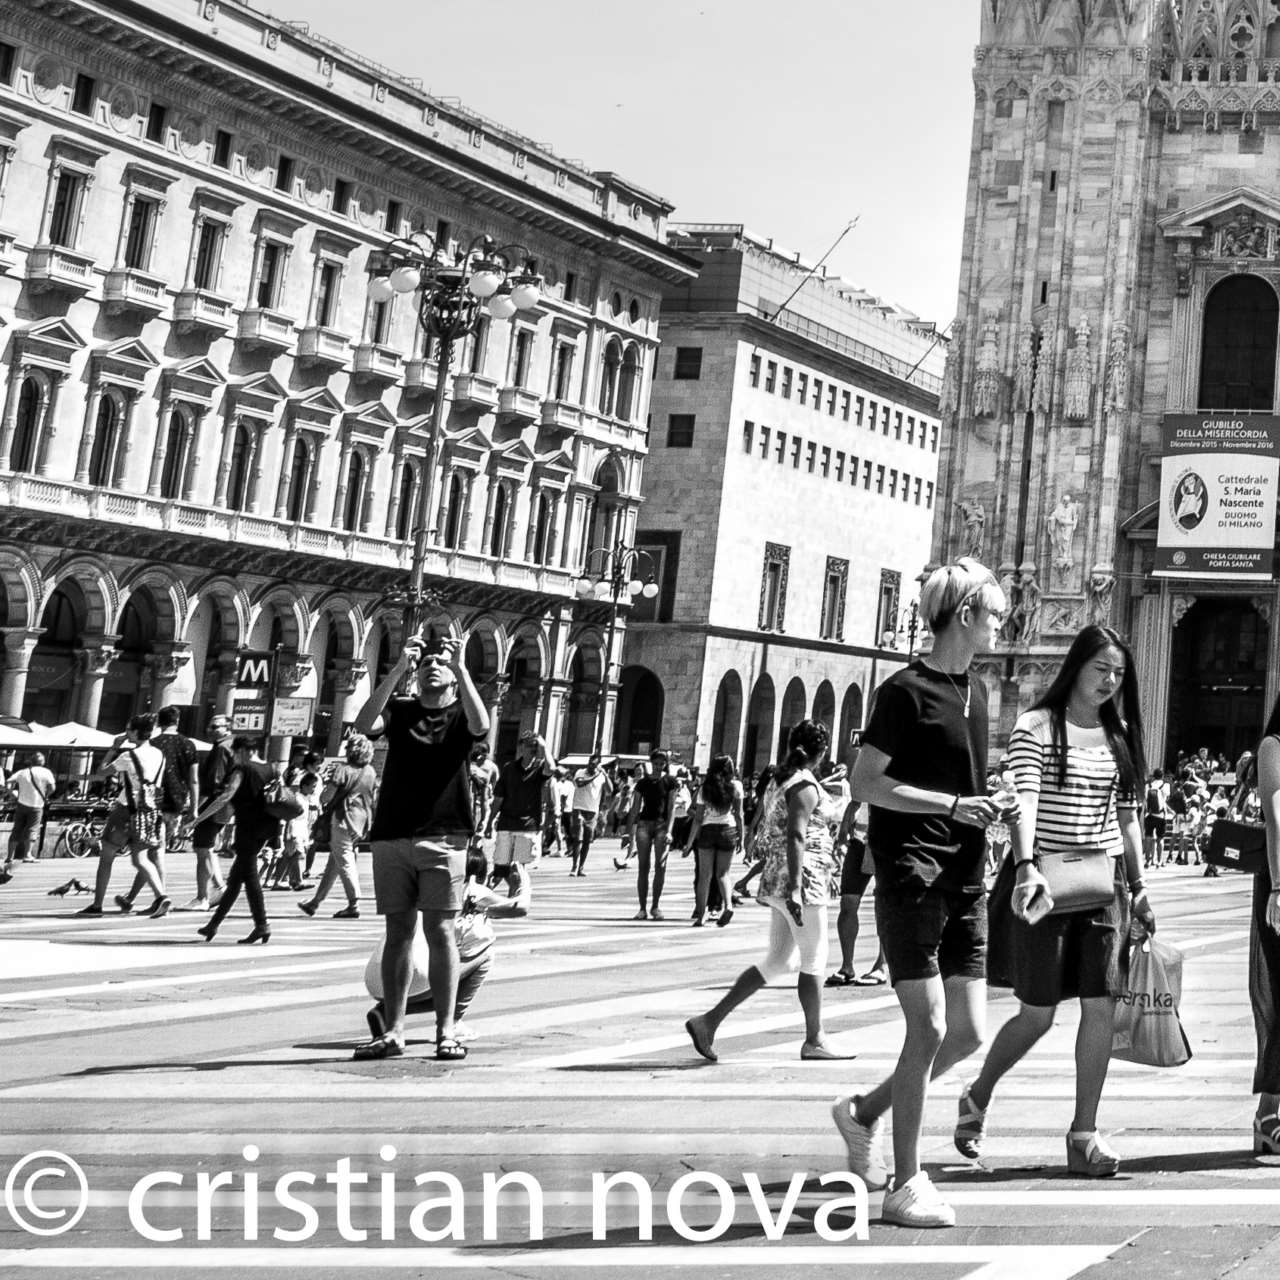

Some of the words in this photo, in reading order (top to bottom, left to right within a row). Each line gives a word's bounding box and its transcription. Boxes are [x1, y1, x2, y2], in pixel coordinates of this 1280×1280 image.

[1202, 420, 1244, 429] GIUBILEO
[1176, 429, 1203, 438] DELLA
[1204, 430, 1268, 439] MISERICORDIA
[1170, 440, 1200, 448] Dicembre
[1257, 441, 1274, 449] 2016
[1218, 474, 1269, 485] Cattedrale
[1234, 486, 1261, 496] Maria
[1219, 498, 1264, 508] Nascente
[1227, 553, 1261, 561] GIUBILARE
[240, 659, 269, 682] M
